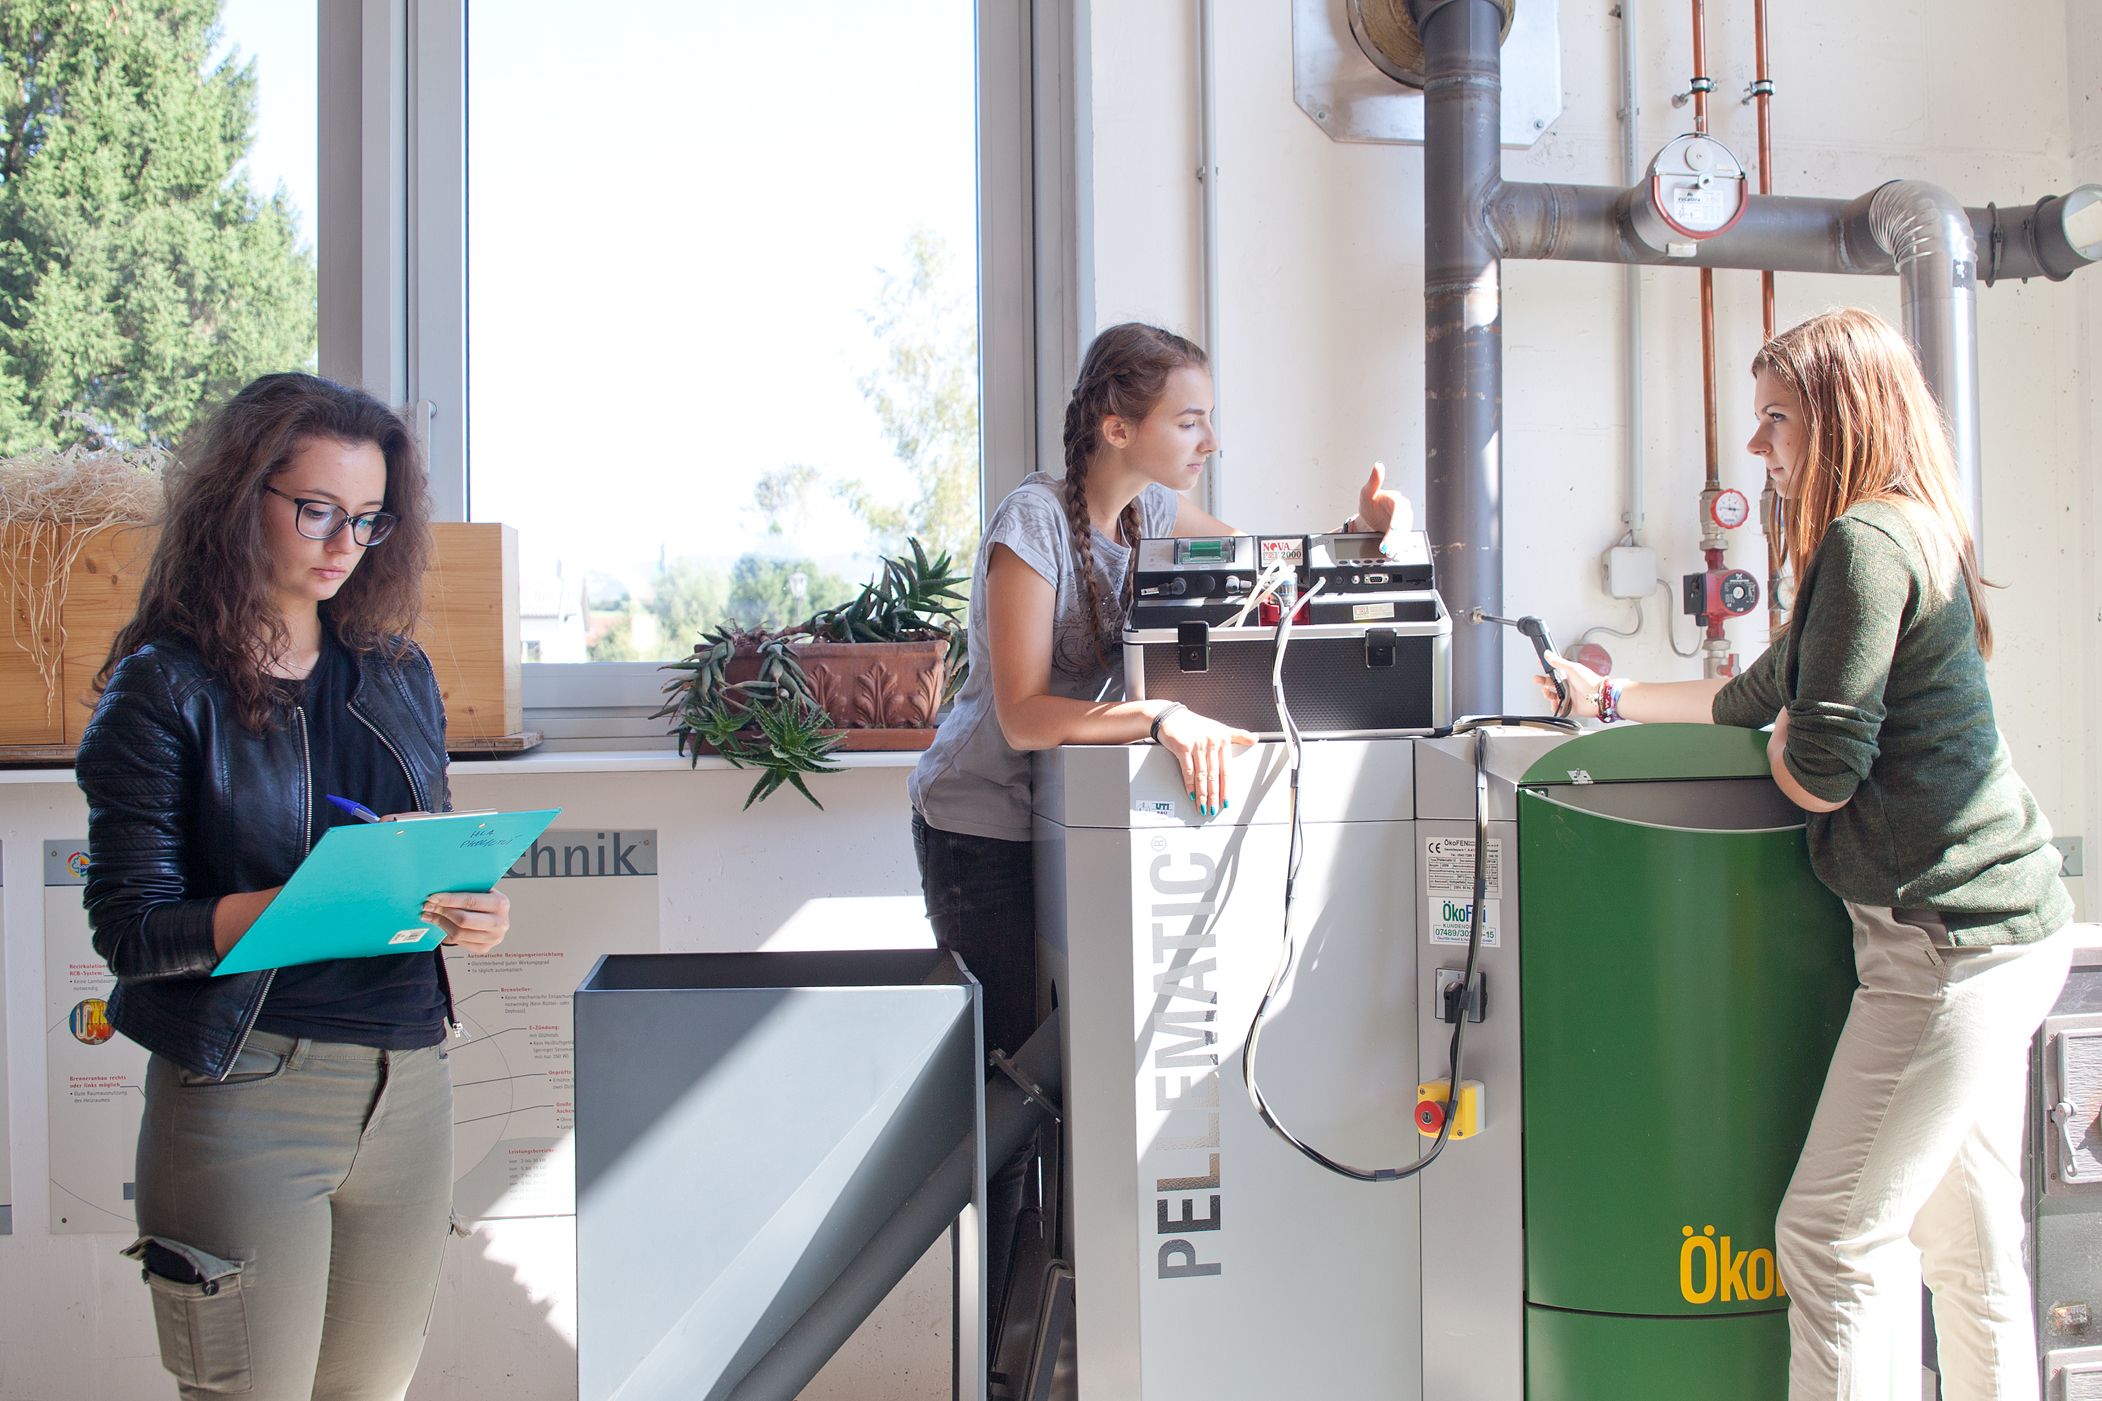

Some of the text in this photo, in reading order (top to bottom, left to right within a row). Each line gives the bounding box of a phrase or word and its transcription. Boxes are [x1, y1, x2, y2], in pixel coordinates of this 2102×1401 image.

[1263, 542, 1290, 551] NOVA
[1280, 550, 1302, 559] 2000
[1149, 852, 1222, 1281] PELLEMATIC
